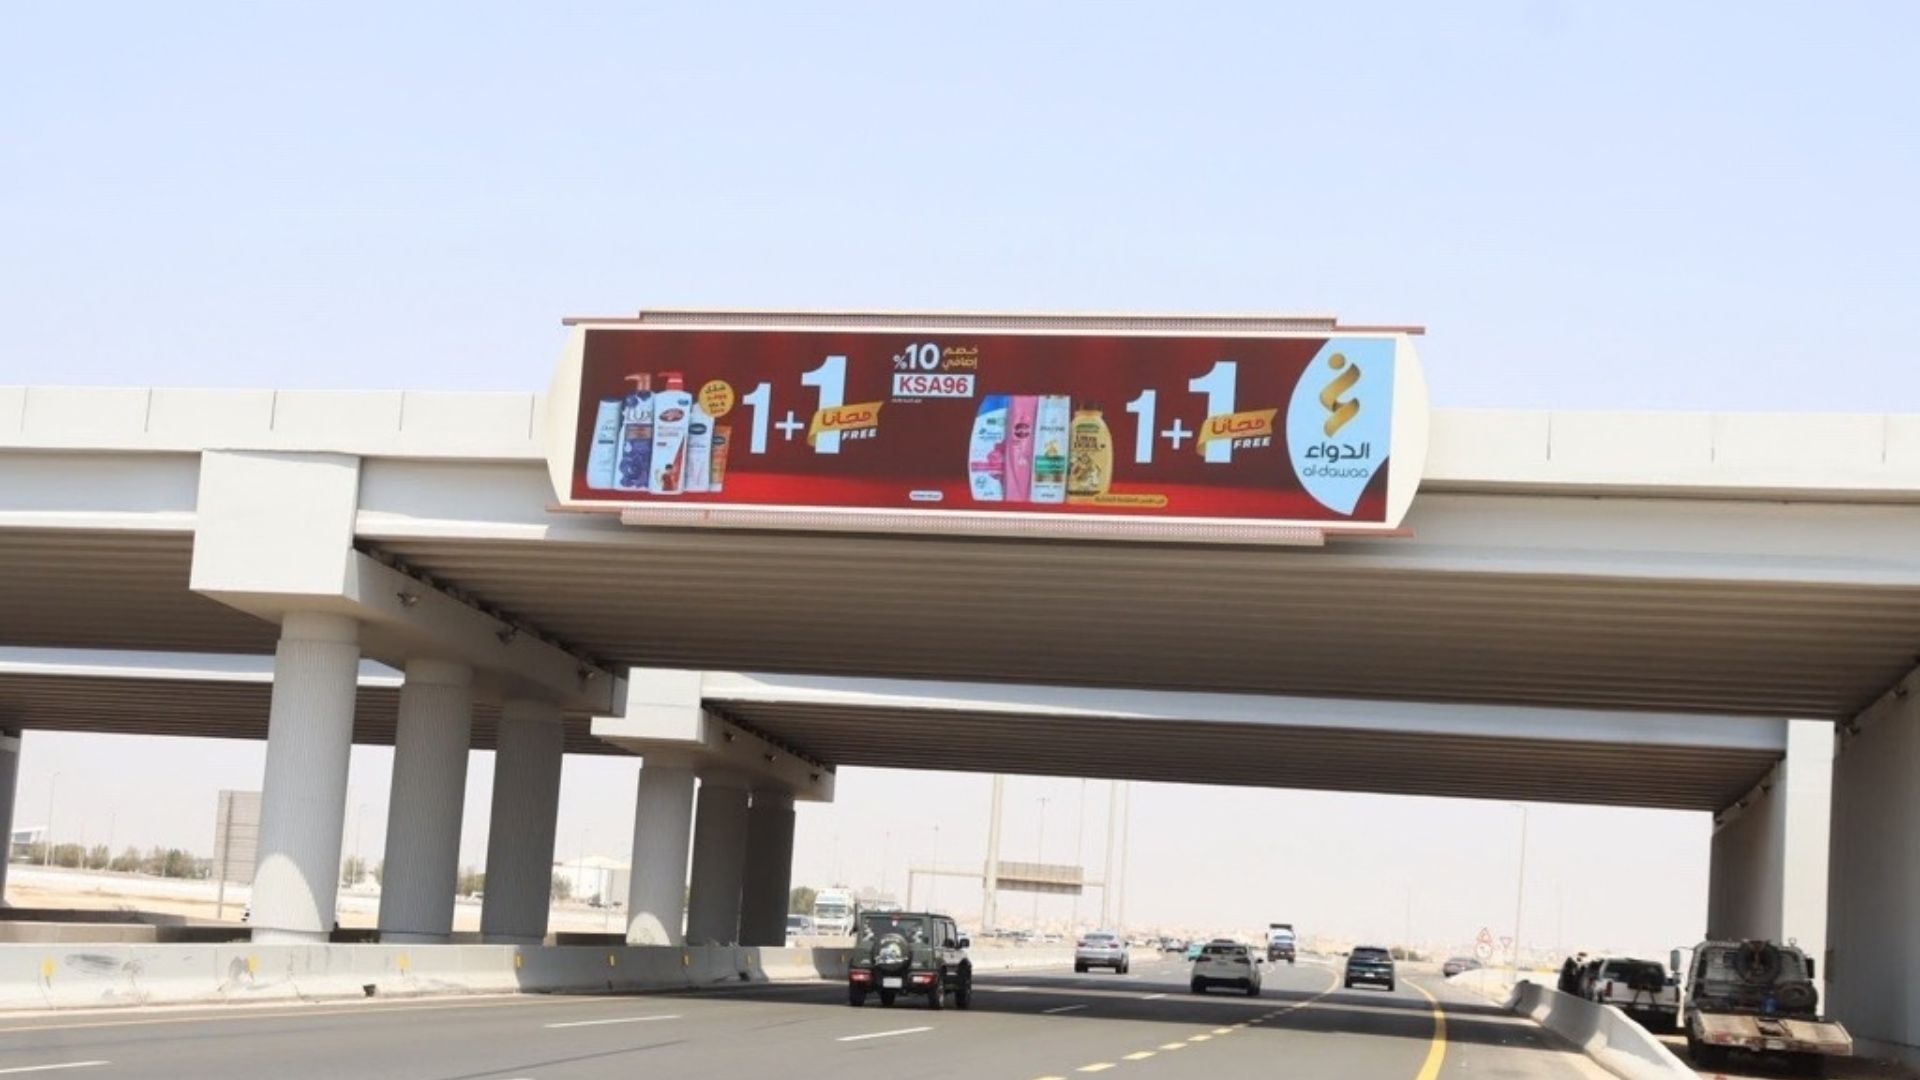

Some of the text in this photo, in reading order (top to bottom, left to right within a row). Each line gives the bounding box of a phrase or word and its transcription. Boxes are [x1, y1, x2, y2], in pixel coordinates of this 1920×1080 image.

[942, 345, 979, 358] خصم
[899, 376, 968, 394] KSA96
[841, 427, 878, 441] FREE
[1233, 436, 1272, 449] FREE
[1304, 441, 1370, 463] الدواء
